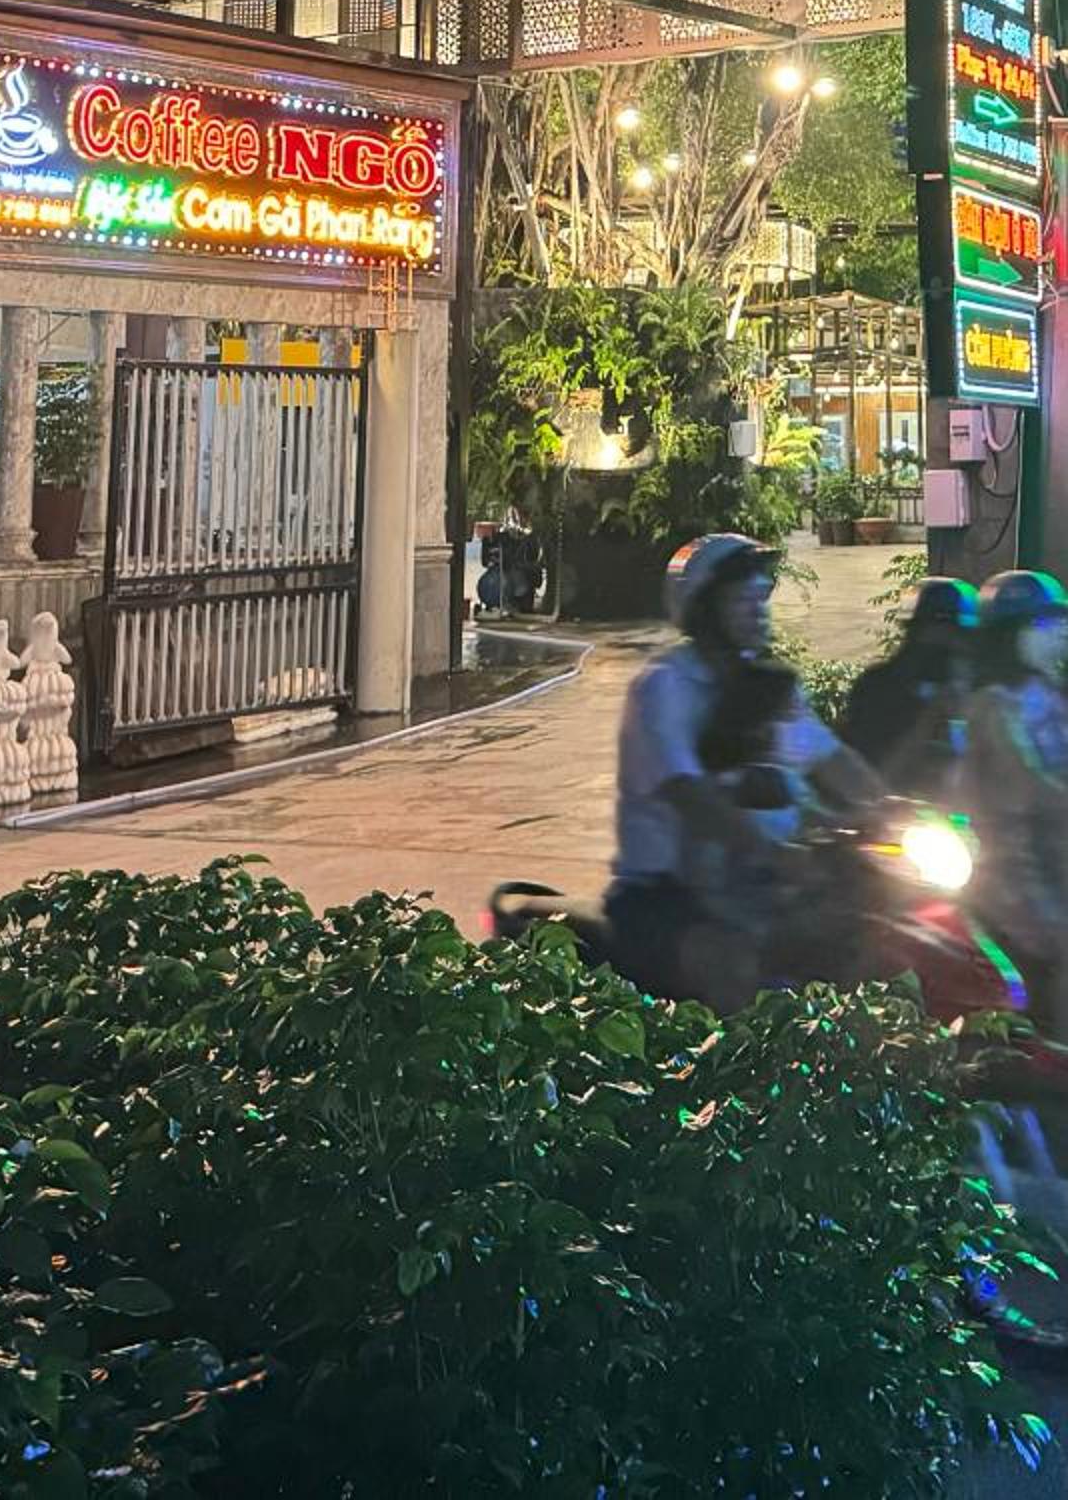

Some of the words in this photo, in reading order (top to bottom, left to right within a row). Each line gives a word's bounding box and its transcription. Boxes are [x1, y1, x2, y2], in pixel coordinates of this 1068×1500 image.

[78, 85, 260, 174] Coffee
[259, 194, 301, 238] Gà
[305, 198, 369, 243] Phan
[372, 207, 435, 260] Rang
